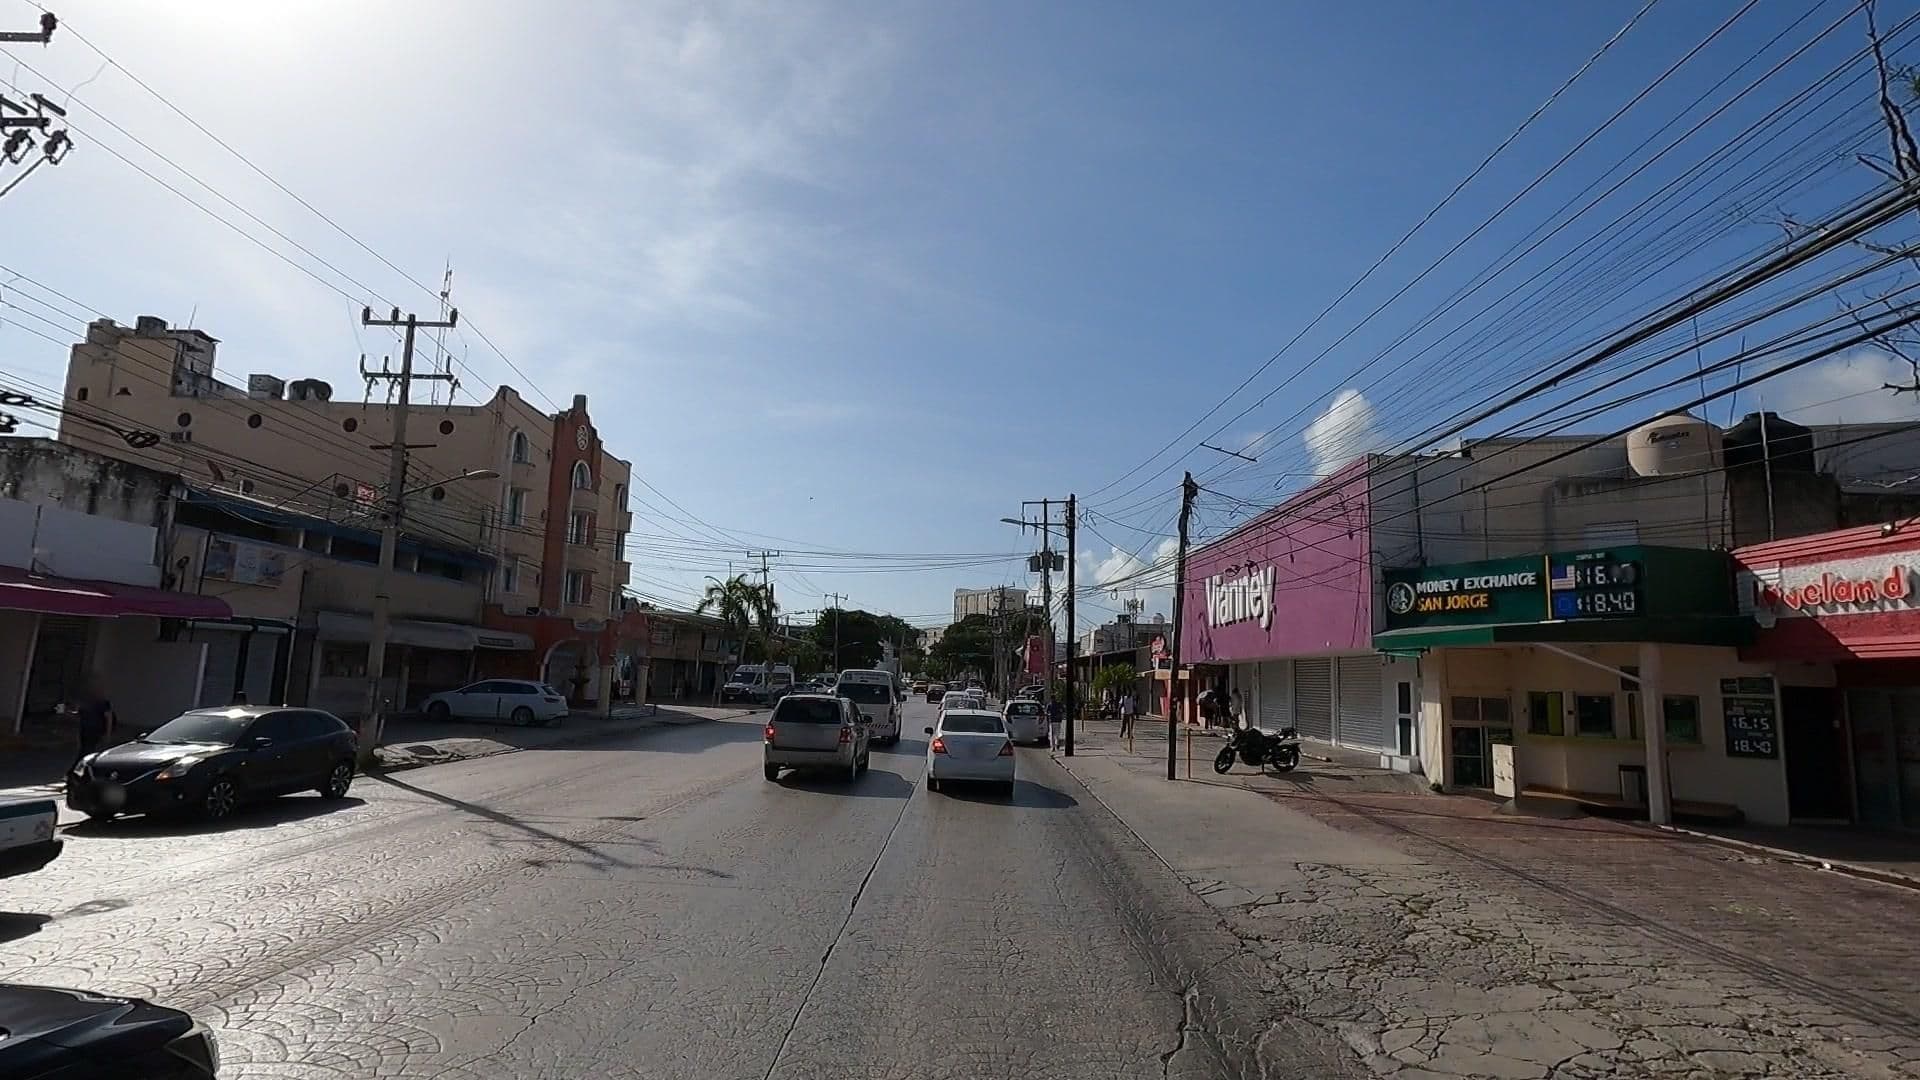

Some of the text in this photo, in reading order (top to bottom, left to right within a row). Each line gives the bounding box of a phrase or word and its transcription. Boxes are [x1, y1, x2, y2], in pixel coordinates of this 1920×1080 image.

[1417, 572, 1537, 594] MONEY EXCHANGE
[1205, 567, 1272, 628] Vianney
[1417, 593, 1489, 612] SAN JORGE
